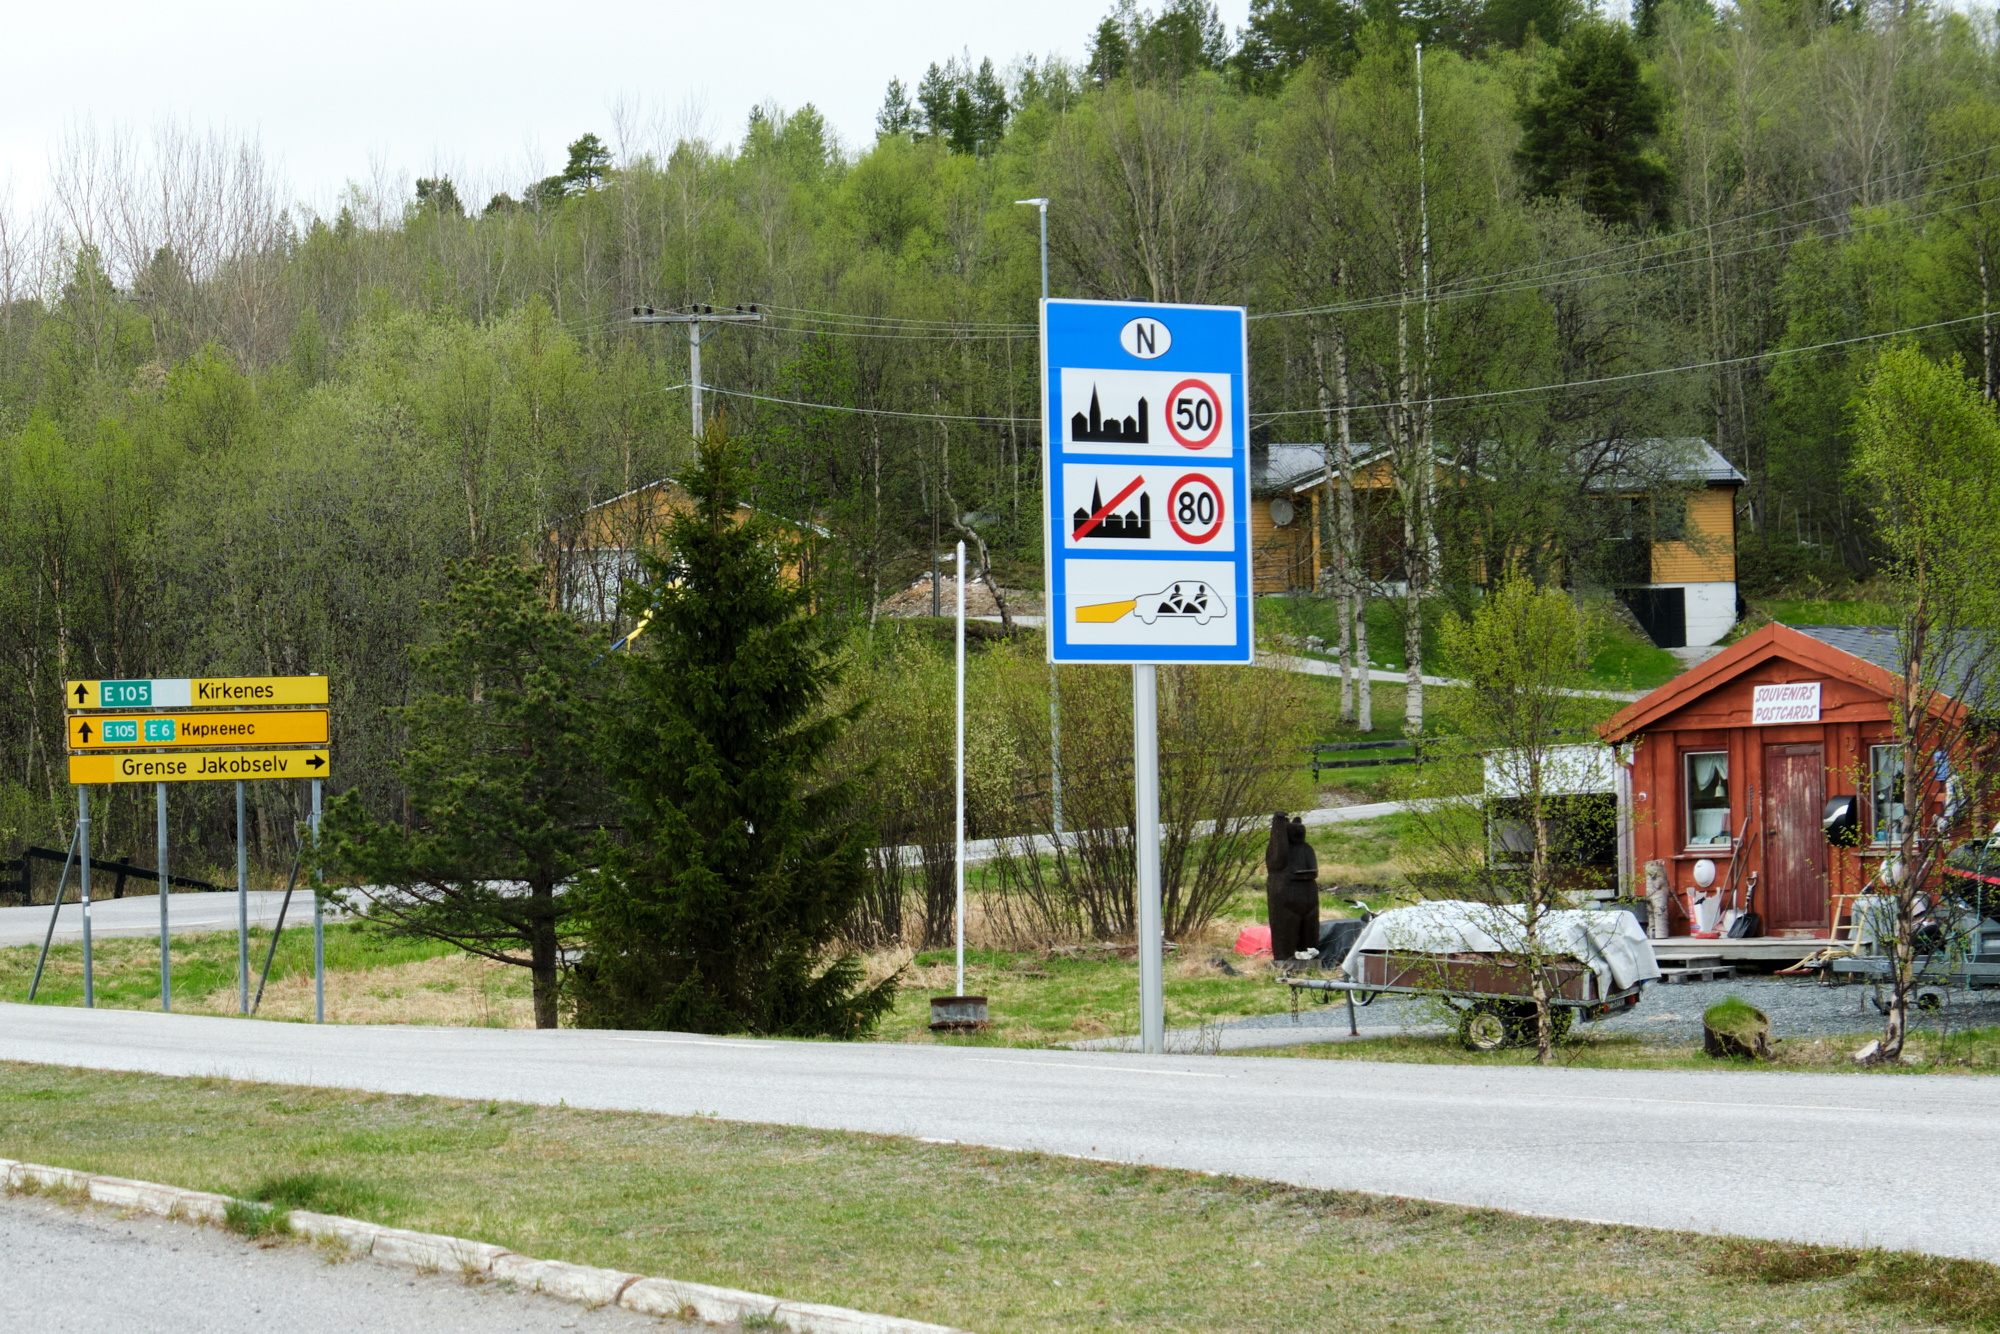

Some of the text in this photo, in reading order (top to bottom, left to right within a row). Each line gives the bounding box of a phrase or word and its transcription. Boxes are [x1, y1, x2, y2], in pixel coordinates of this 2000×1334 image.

[1136, 322, 1156, 355] N
[1176, 398, 1213, 431] 50
[1178, 491, 1215, 525] 80
[104, 687, 114, 702] E
[119, 686, 148, 701] 105
[198, 682, 274, 699] Kirkenes
[1755, 685, 1816, 702] SOUVENIRS
[1754, 705, 1817, 721] POSTCARDS
[150, 725, 158, 736] E
[161, 724, 170, 736] 6
[181, 723, 255, 738] Киркенес
[122, 756, 288, 776] Grense Jakobselv
